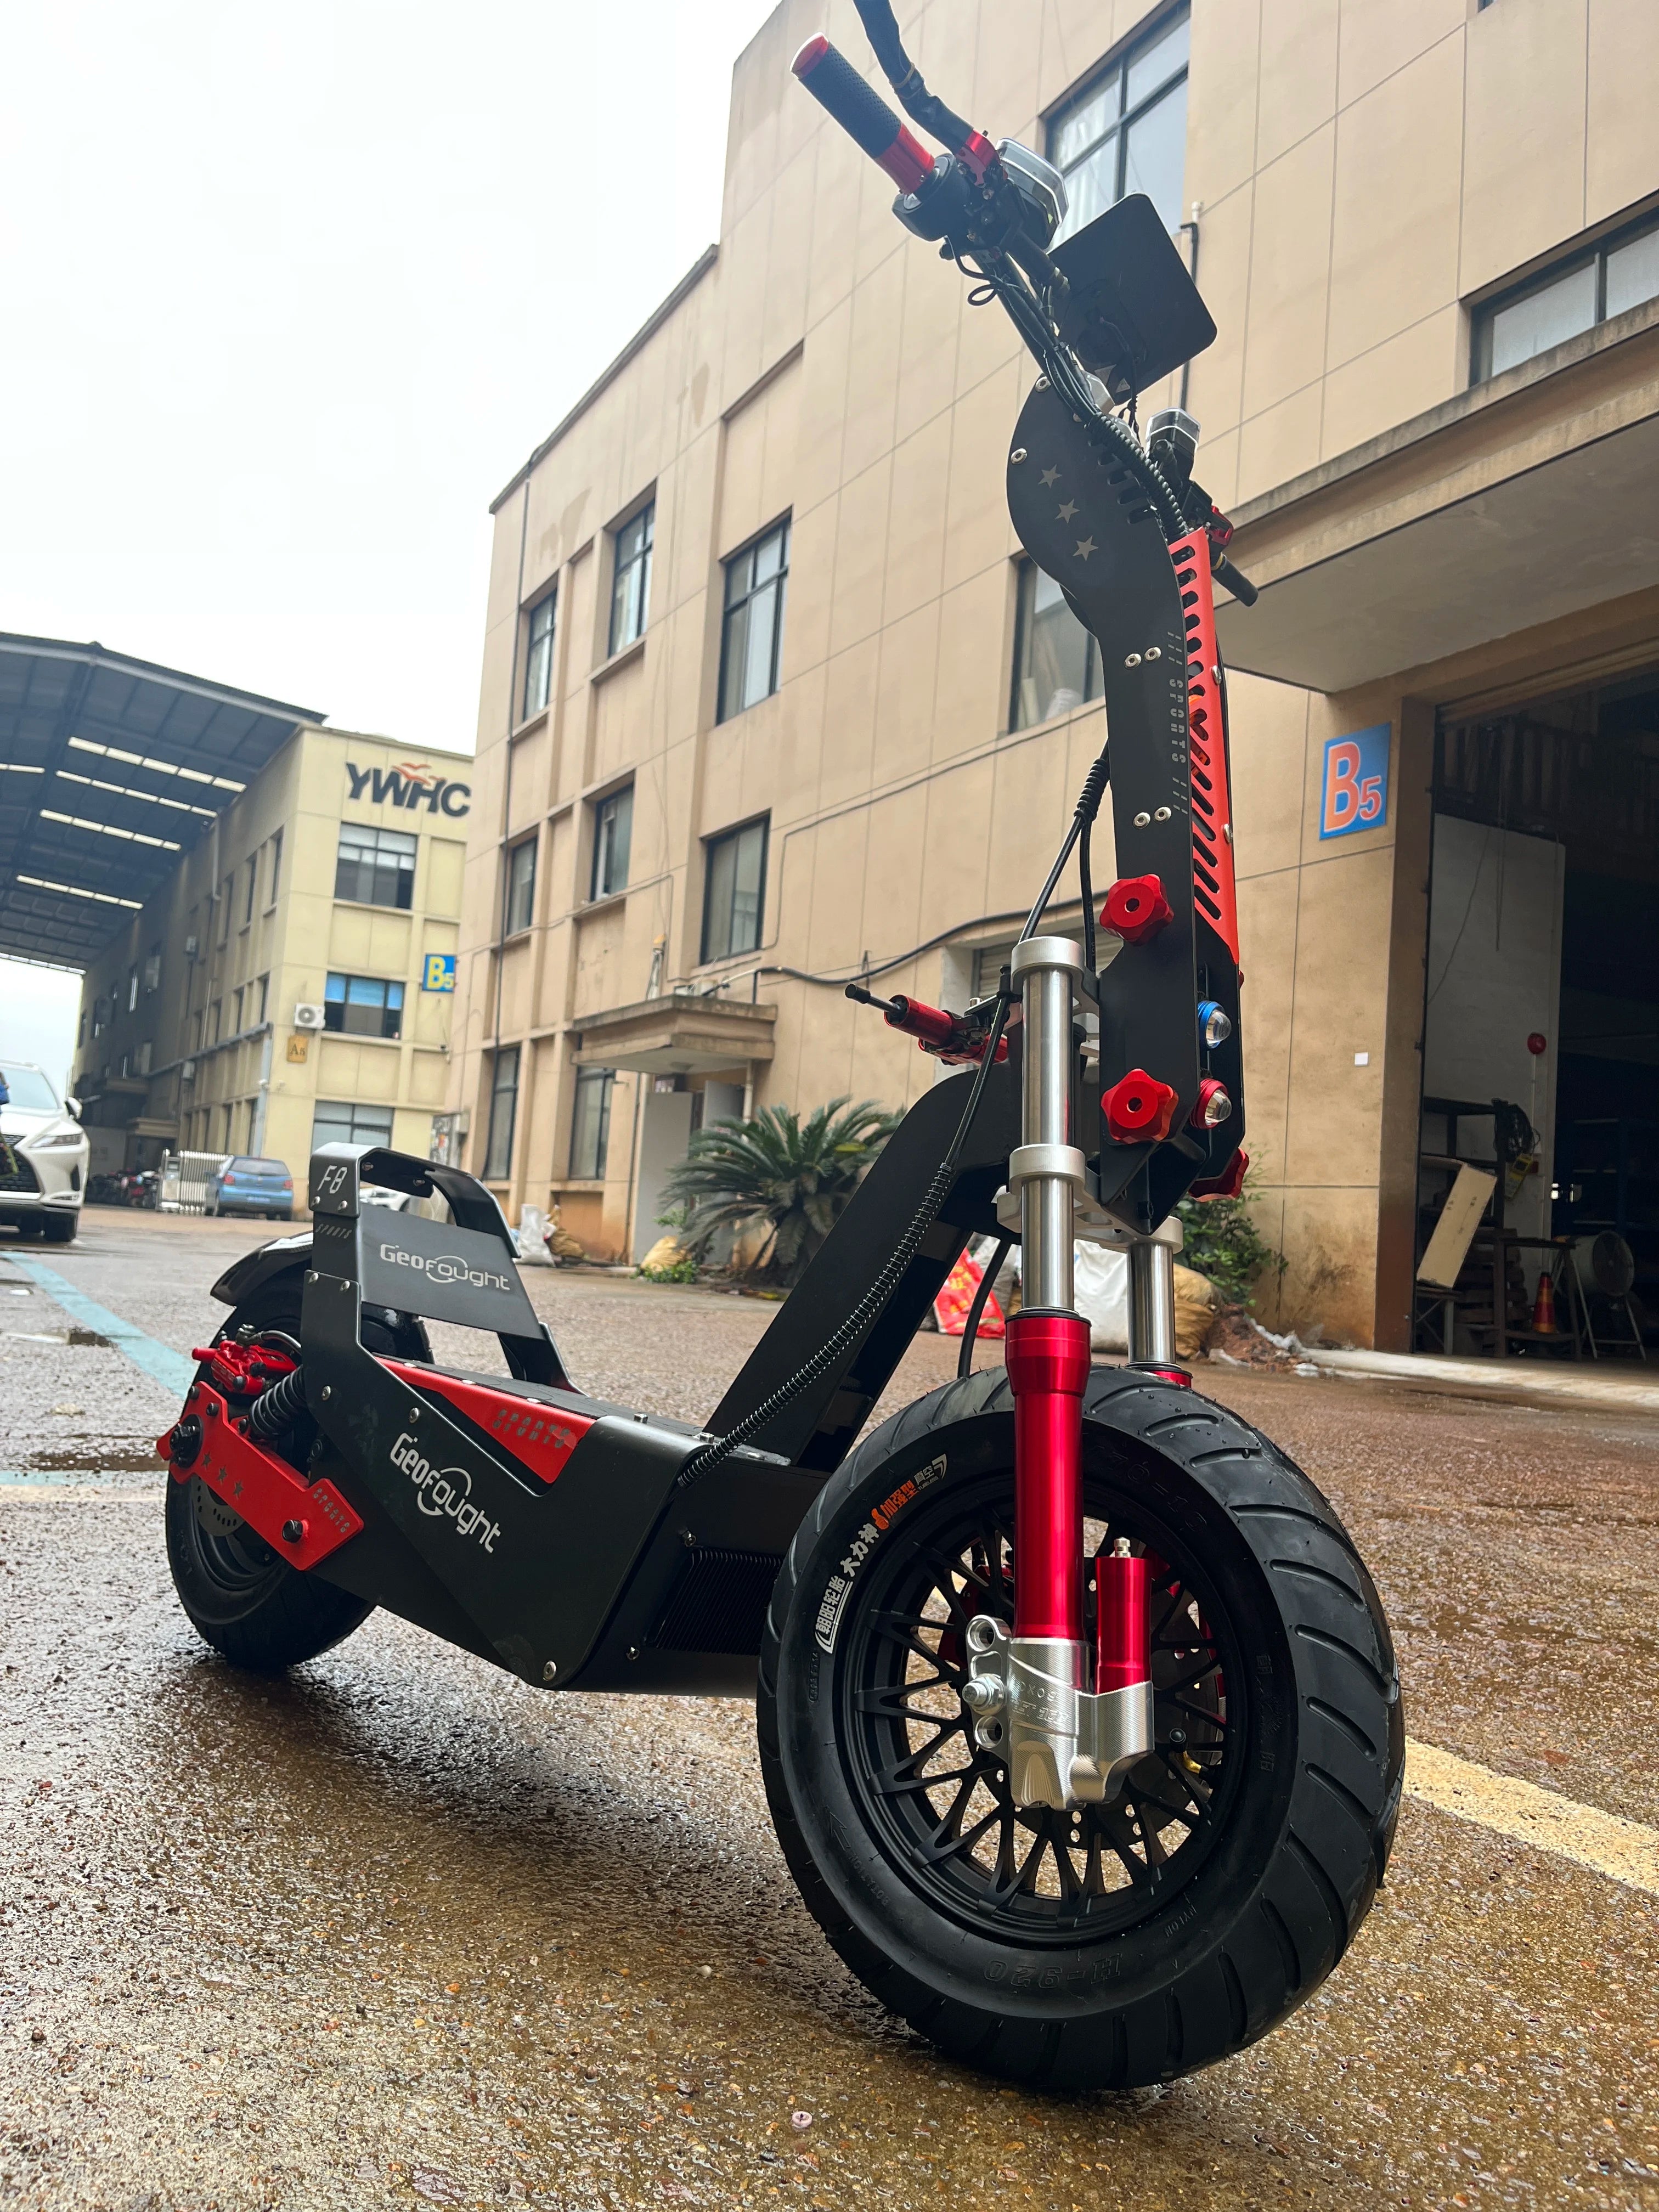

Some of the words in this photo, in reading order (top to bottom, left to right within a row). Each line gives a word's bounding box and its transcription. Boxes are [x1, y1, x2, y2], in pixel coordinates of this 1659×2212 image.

[345, 762, 471, 817] YWHC
[1324, 742, 1381, 833] B5
[427, 956, 454, 989] B5
[290, 1043, 305, 1056] A5
[317, 1165, 348, 1193] F8
[815, 1575, 845, 1634] 朝阳轮胎
[840, 1523, 879, 1577] 大力神
[983, 1953, 1122, 1989] H-920
